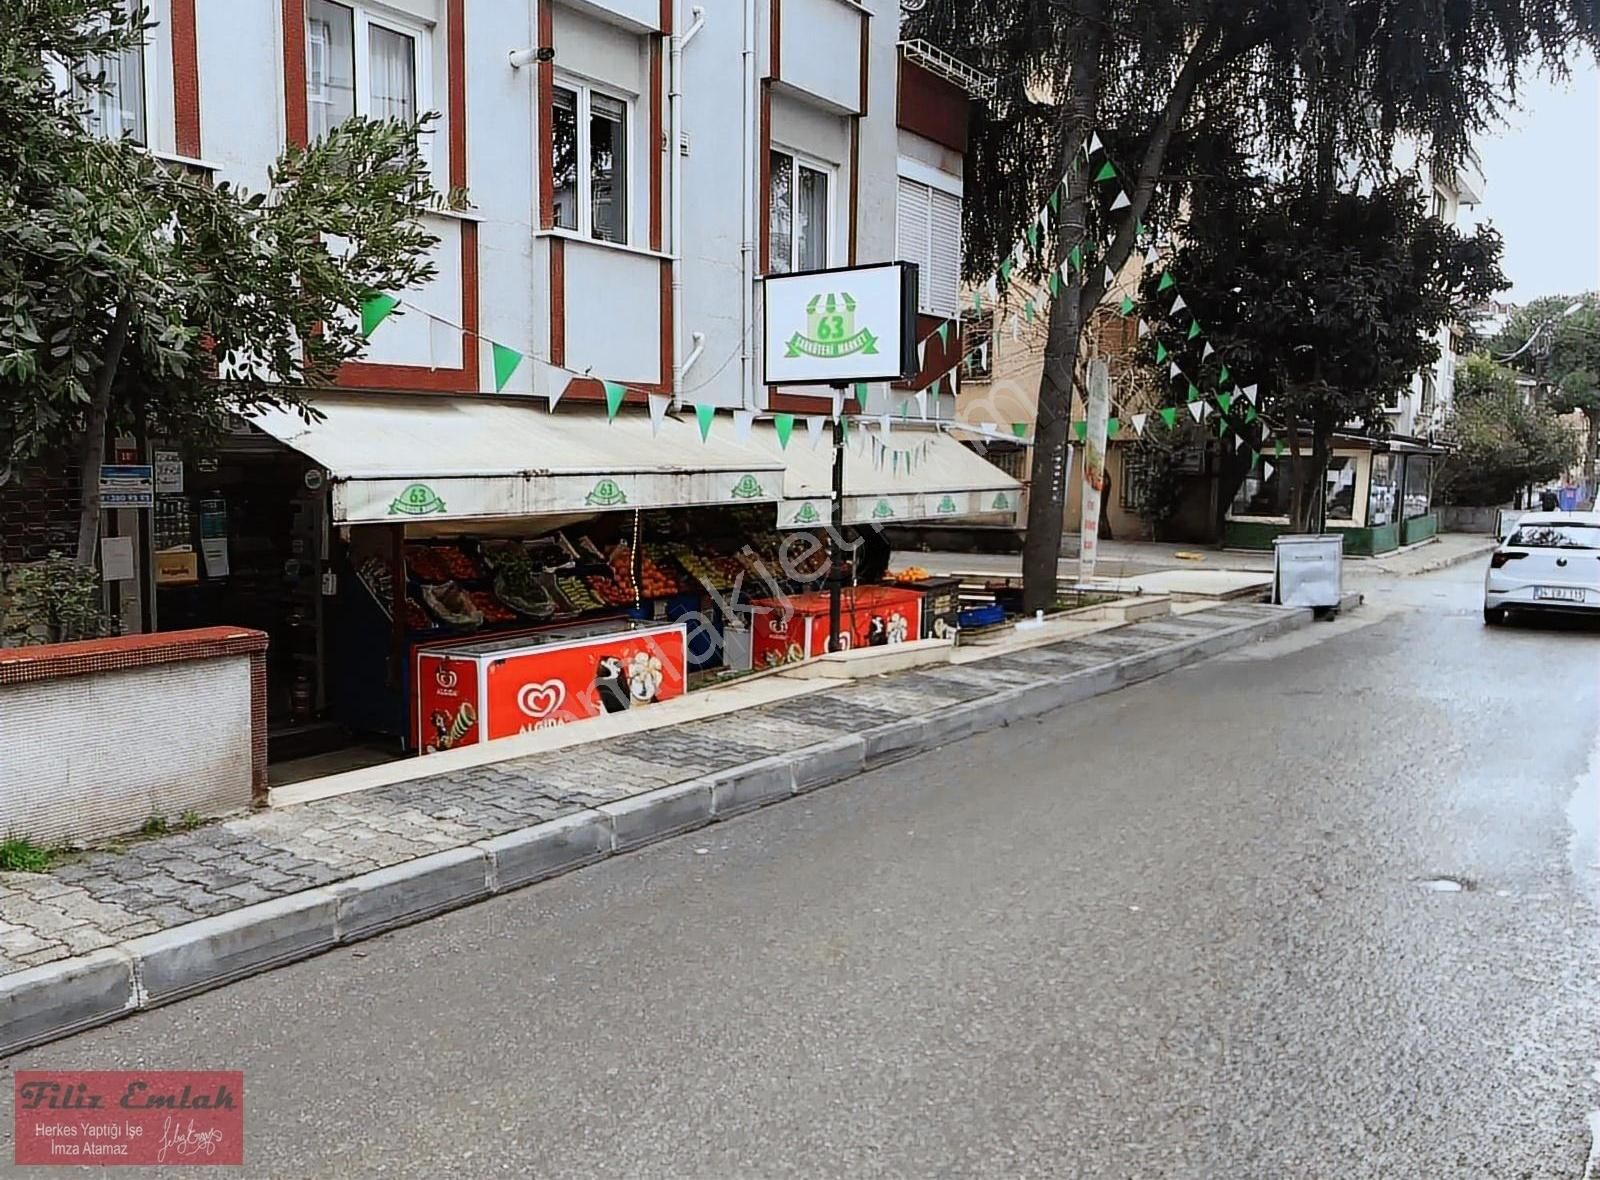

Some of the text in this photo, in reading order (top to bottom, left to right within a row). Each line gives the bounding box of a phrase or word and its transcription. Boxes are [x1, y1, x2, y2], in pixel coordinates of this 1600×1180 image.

[816, 315, 844, 340] 63
[410, 488, 426, 503] 63
[599, 483, 613, 496] 63
